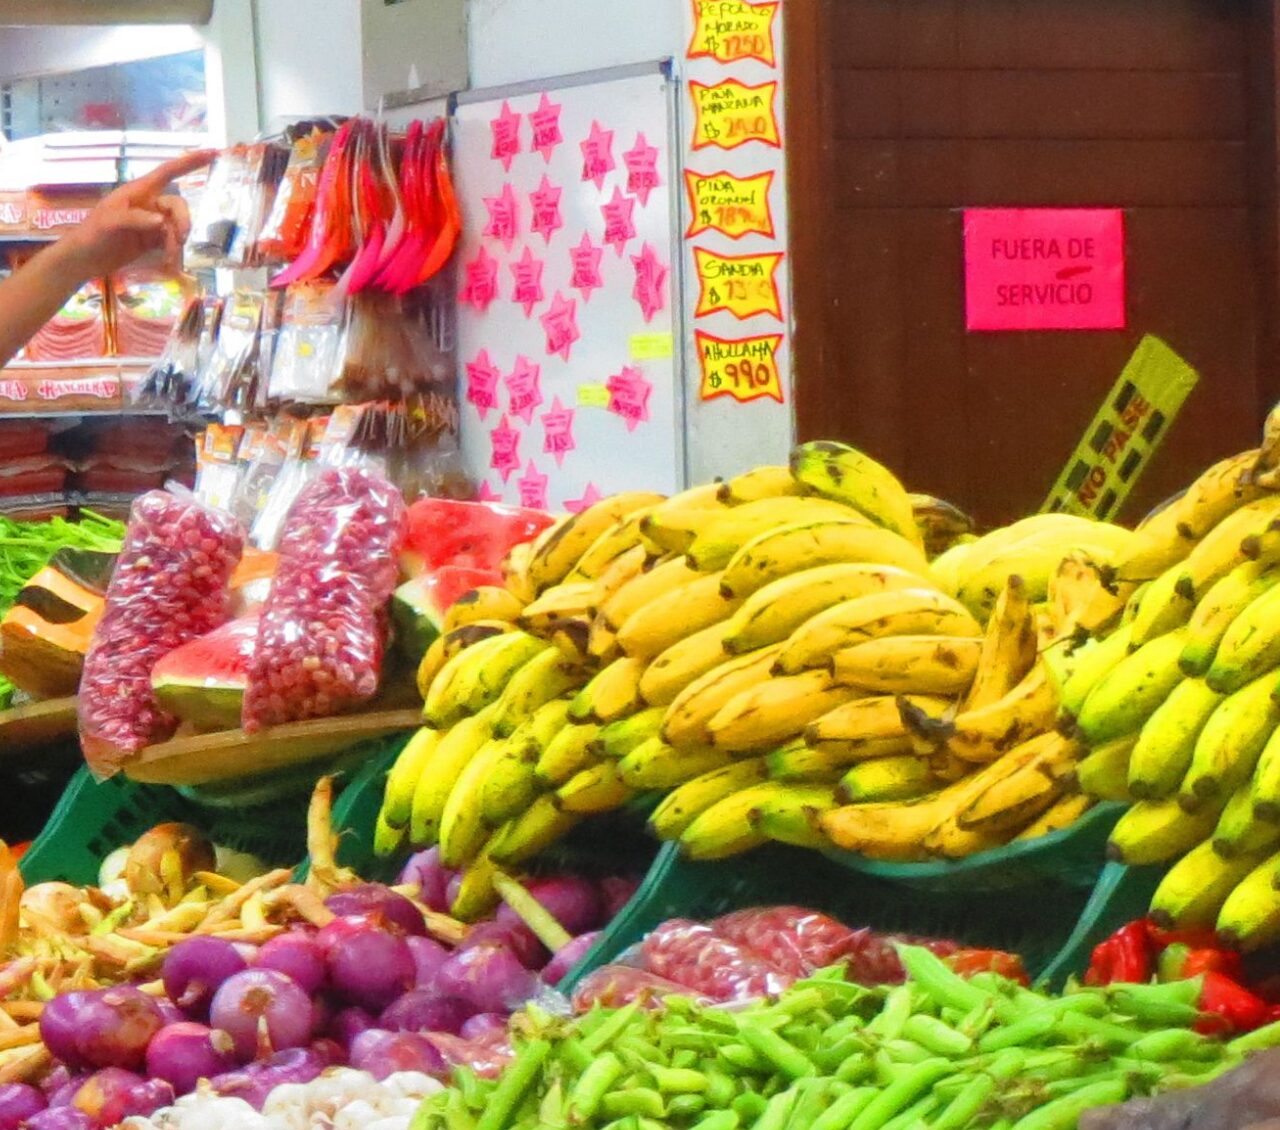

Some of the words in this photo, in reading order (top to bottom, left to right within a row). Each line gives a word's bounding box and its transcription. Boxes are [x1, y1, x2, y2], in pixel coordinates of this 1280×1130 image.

[991, 238, 1061, 260] FUERA
[1067, 237, 1095, 259] DE
[996, 283, 1093, 306] SERVICIO
[42, 380, 115, 399] RANCHERA
[1077, 465, 1107, 509] NO
